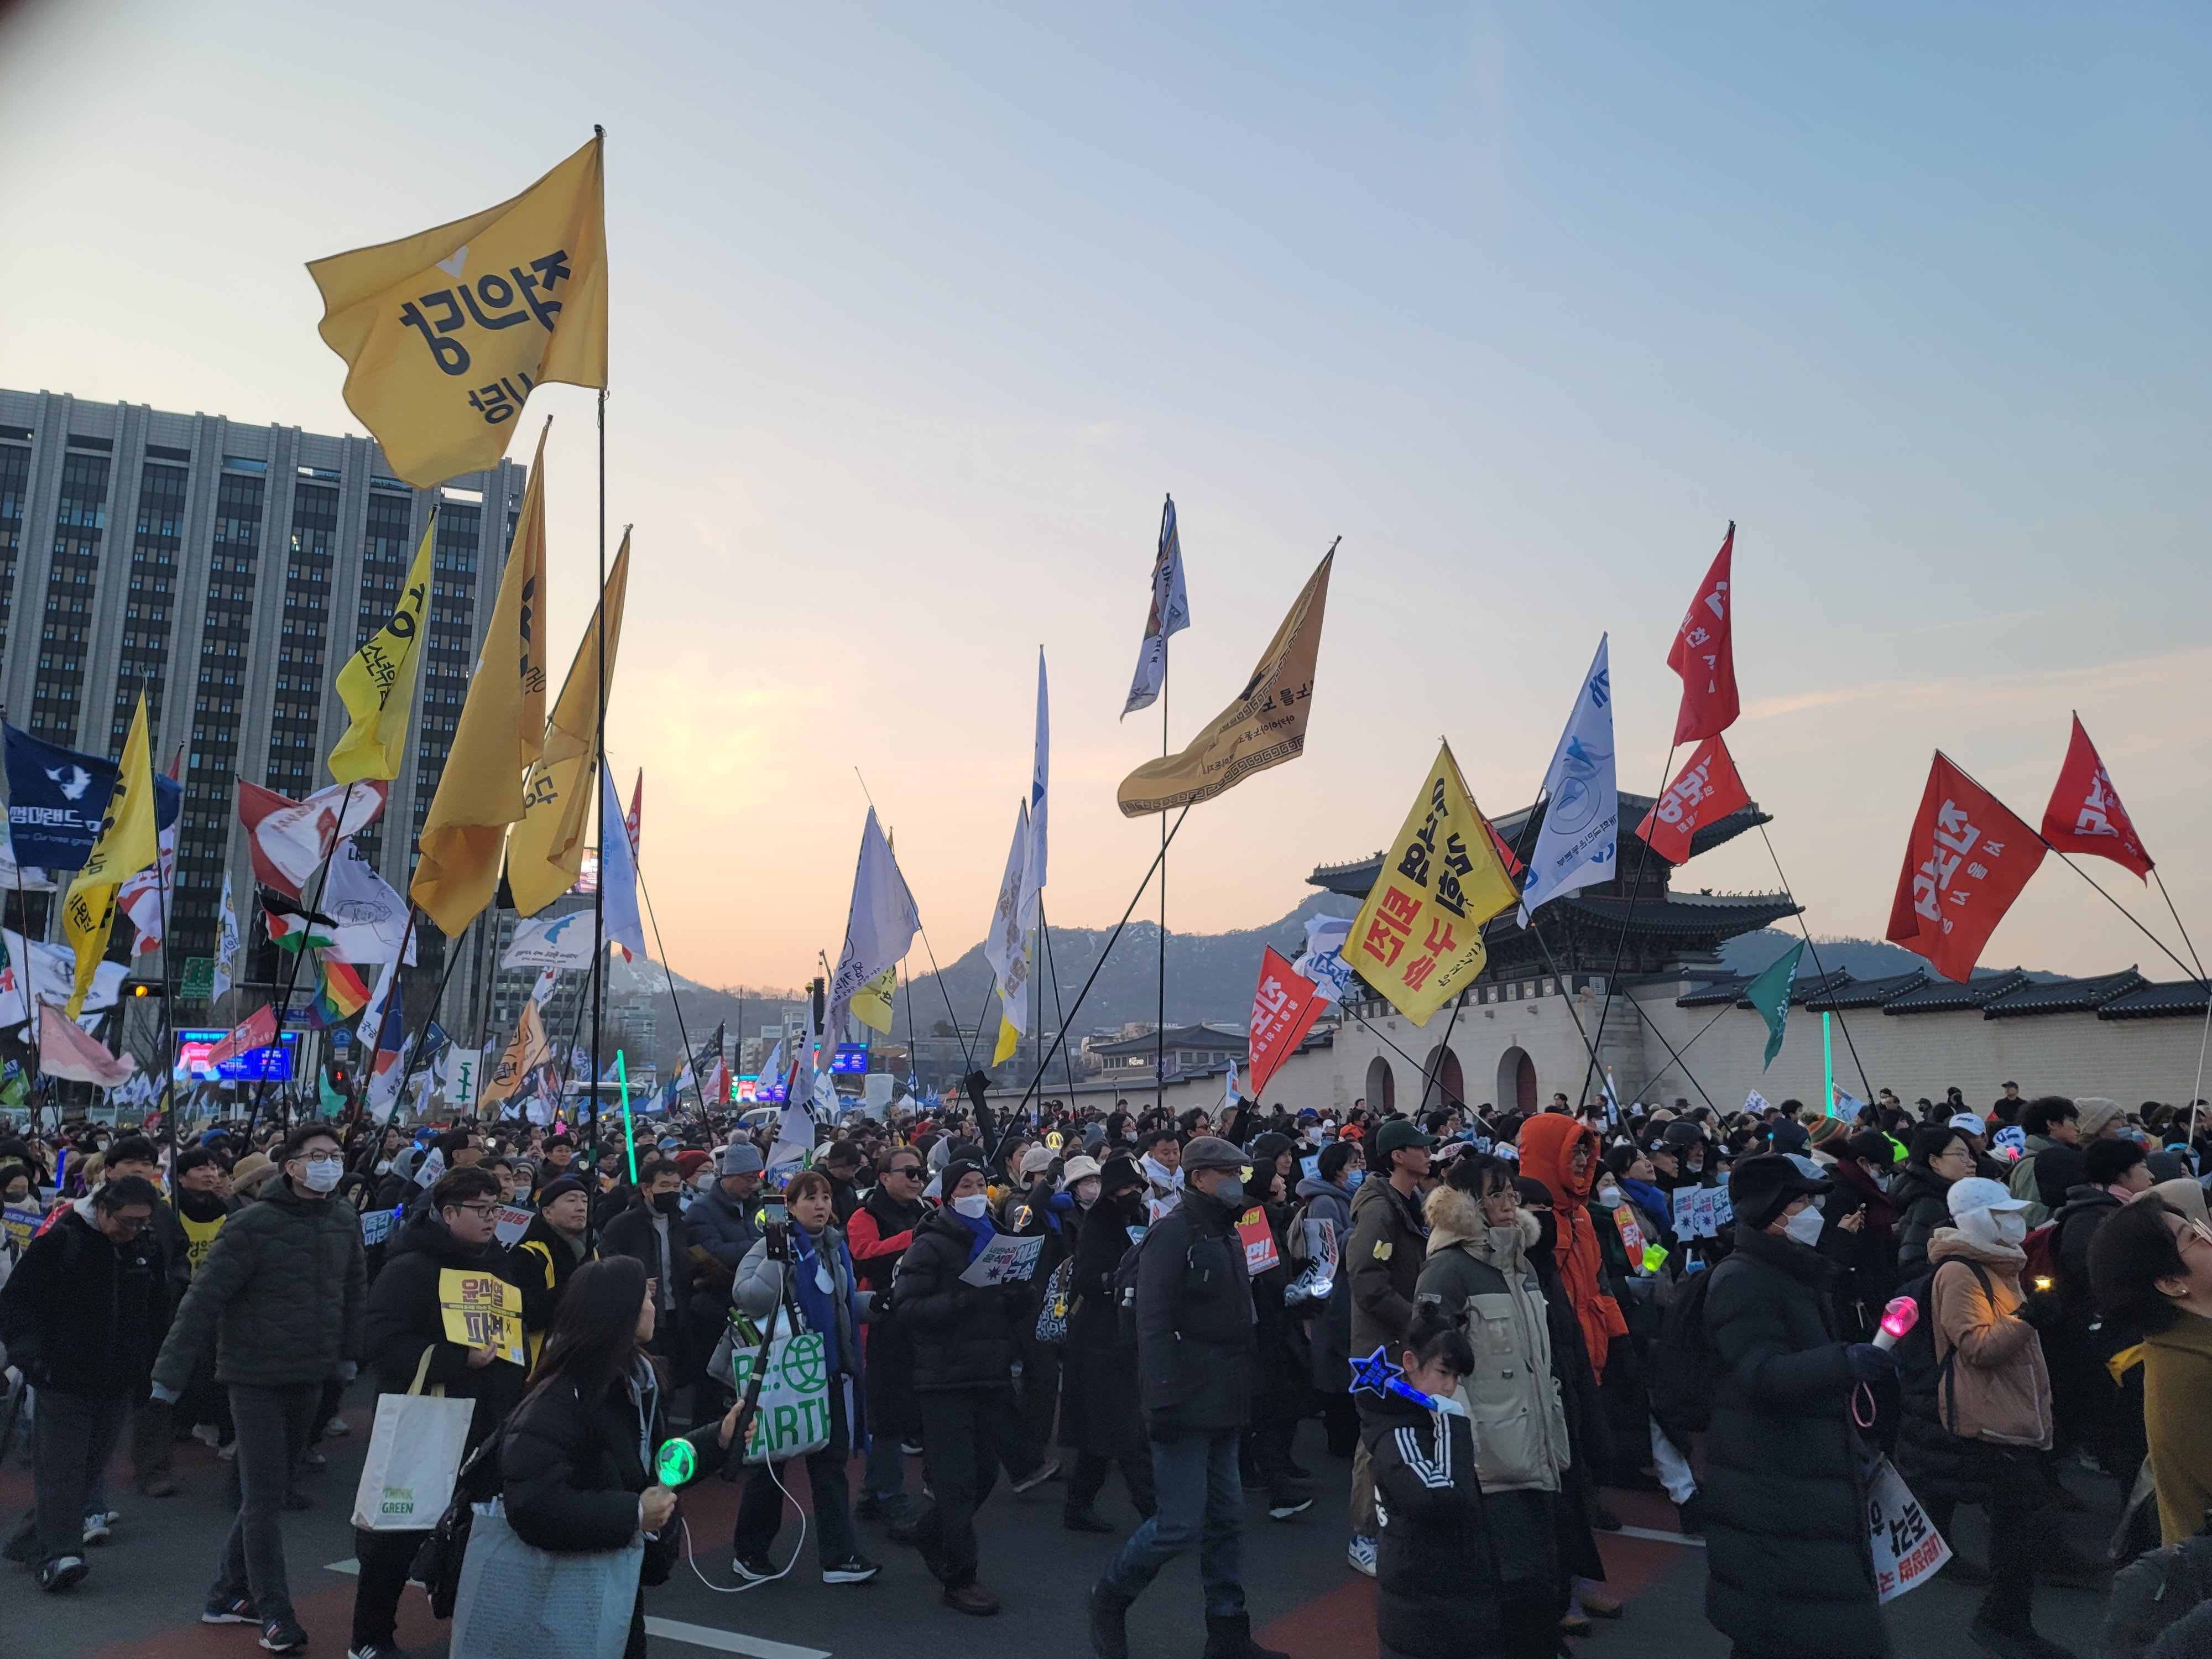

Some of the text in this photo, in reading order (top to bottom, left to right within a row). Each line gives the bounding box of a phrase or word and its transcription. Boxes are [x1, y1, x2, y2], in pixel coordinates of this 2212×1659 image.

[1246, 1237, 1271, 1264] 면!
[461, 1279, 504, 1308] 윤석열
[463, 1311, 505, 1350] 파면
[745, 1397, 831, 1456] ARTH
[382, 1501, 414, 1515] GREEN
